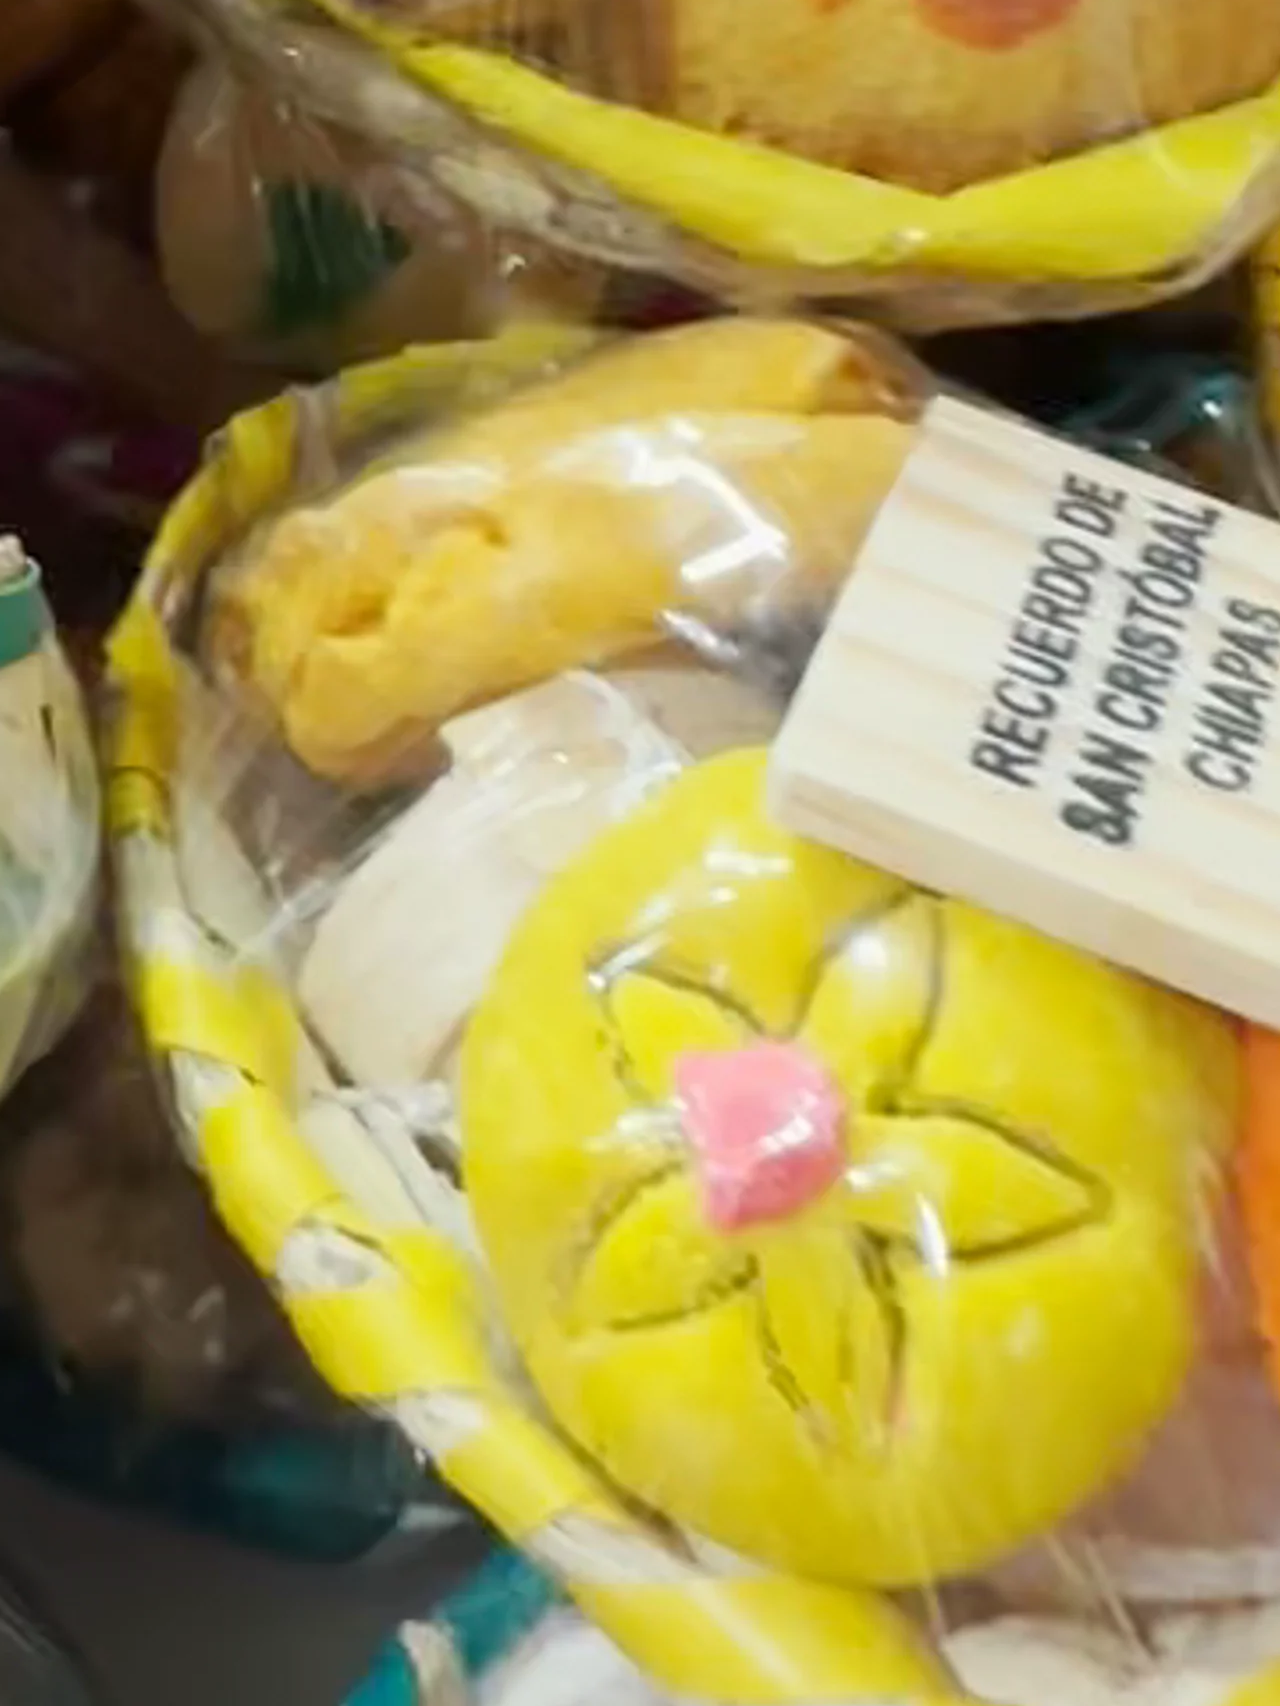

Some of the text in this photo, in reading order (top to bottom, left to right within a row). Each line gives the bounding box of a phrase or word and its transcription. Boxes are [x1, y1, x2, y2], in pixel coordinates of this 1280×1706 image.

[970, 472, 1130, 789] RECUERDO DE
[1058, 500, 1224, 848] SAN CRISTÓBAL
